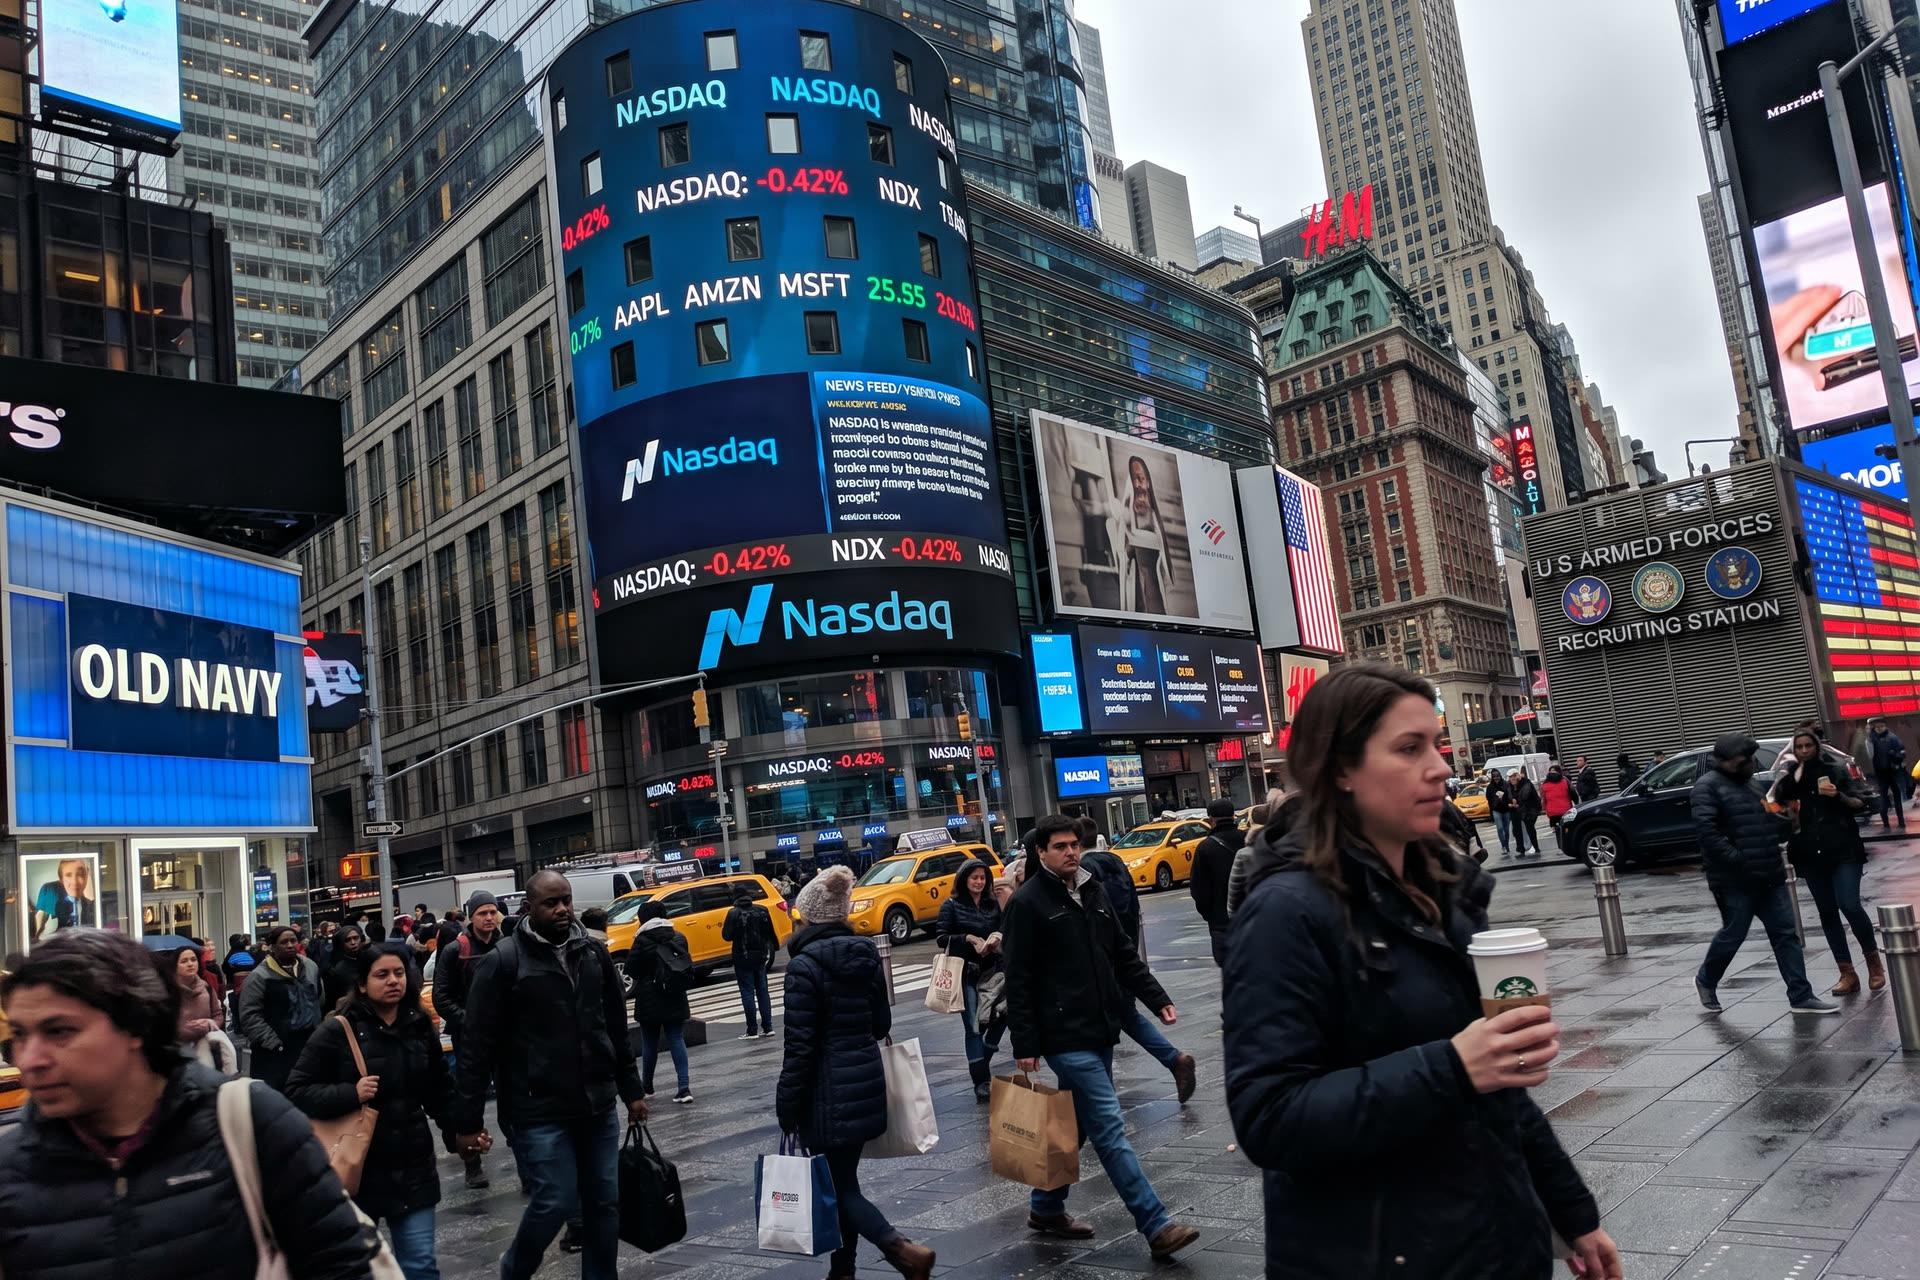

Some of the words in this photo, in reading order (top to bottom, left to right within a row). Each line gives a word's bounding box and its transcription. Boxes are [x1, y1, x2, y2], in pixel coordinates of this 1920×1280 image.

[616, 79, 727, 128] NASDAQ
[770, 76, 881, 118] NASDAQ
[1767, 88, 1824, 119] Marriott
[636, 170, 749, 213] NASDAQ:
[756, 167, 849, 195] -0.42%
[878, 176, 921, 210] NDX
[1300, 183, 1372, 258] H&M
[614, 292, 670, 331] AAPL
[684, 275, 761, 310] AMZN
[779, 273, 850, 298] MSFT
[866, 276, 926, 308] 25.55
[825, 380, 865, 392] NEWS
[829, 417, 879, 430] NASDAQ
[663, 436, 778, 477] Nasdaq
[891, 463, 903, 475] by
[1536, 559, 1553, 577] U
[1557, 555, 1573, 574] S
[1579, 535, 1663, 571] ARMED
[1669, 512, 1773, 551] FORCES
[613, 559, 697, 601] NASDAQ:
[703, 543, 791, 576] -0.42%
[831, 537, 886, 563] NDX
[892, 537, 962, 563] -0.42%
[782, 590, 953, 641] Nasdaq
[1558, 616, 1682, 653] RECRUITING
[1688, 599, 1781, 632] STATION
[78, 643, 170, 704] OLD
[180, 659, 282, 718] NAVY
[768, 757, 832, 778] NASDAQ:
[835, 752, 884, 769] -0.42%
[1064, 769, 1100, 783] NASDAQ
